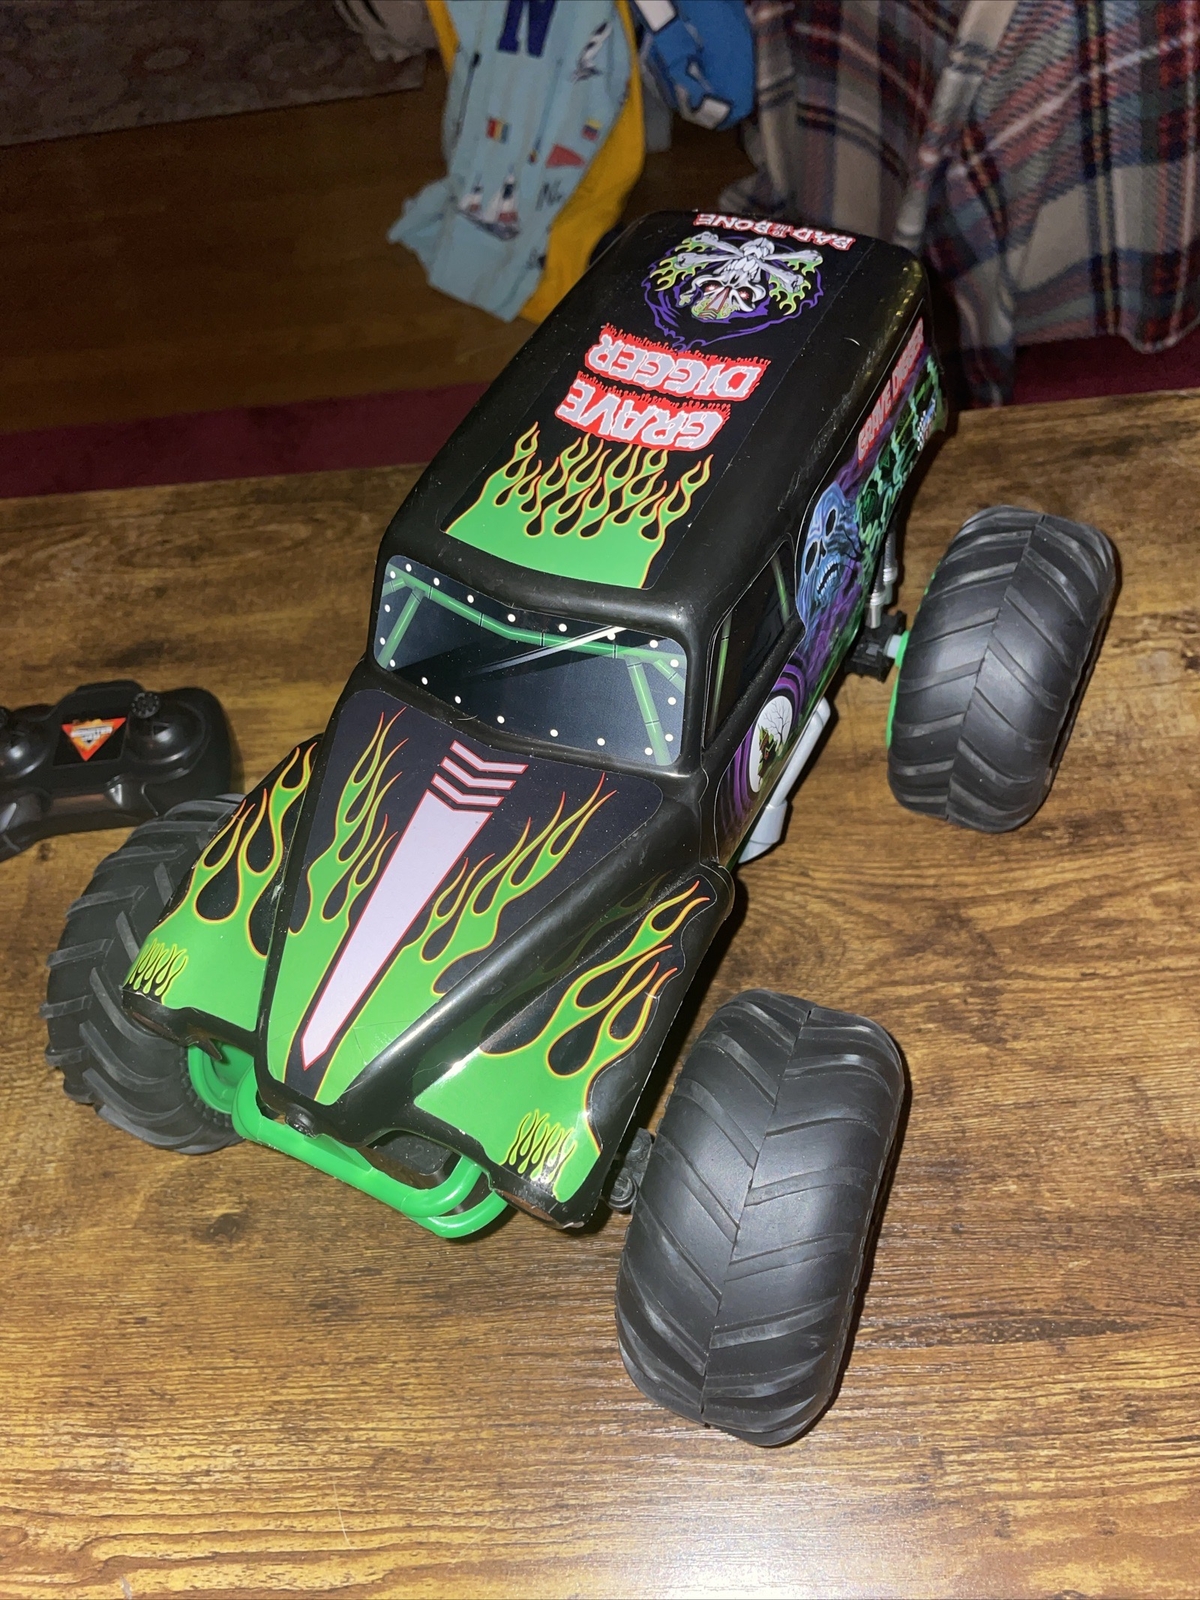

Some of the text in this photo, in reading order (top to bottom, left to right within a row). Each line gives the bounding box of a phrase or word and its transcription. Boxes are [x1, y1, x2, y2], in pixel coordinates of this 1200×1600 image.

[694, 213, 773, 234] BONE
[793, 227, 854, 249] BAD
[588, 334, 764, 398] DIGGER
[557, 379, 725, 449] GRAVE
